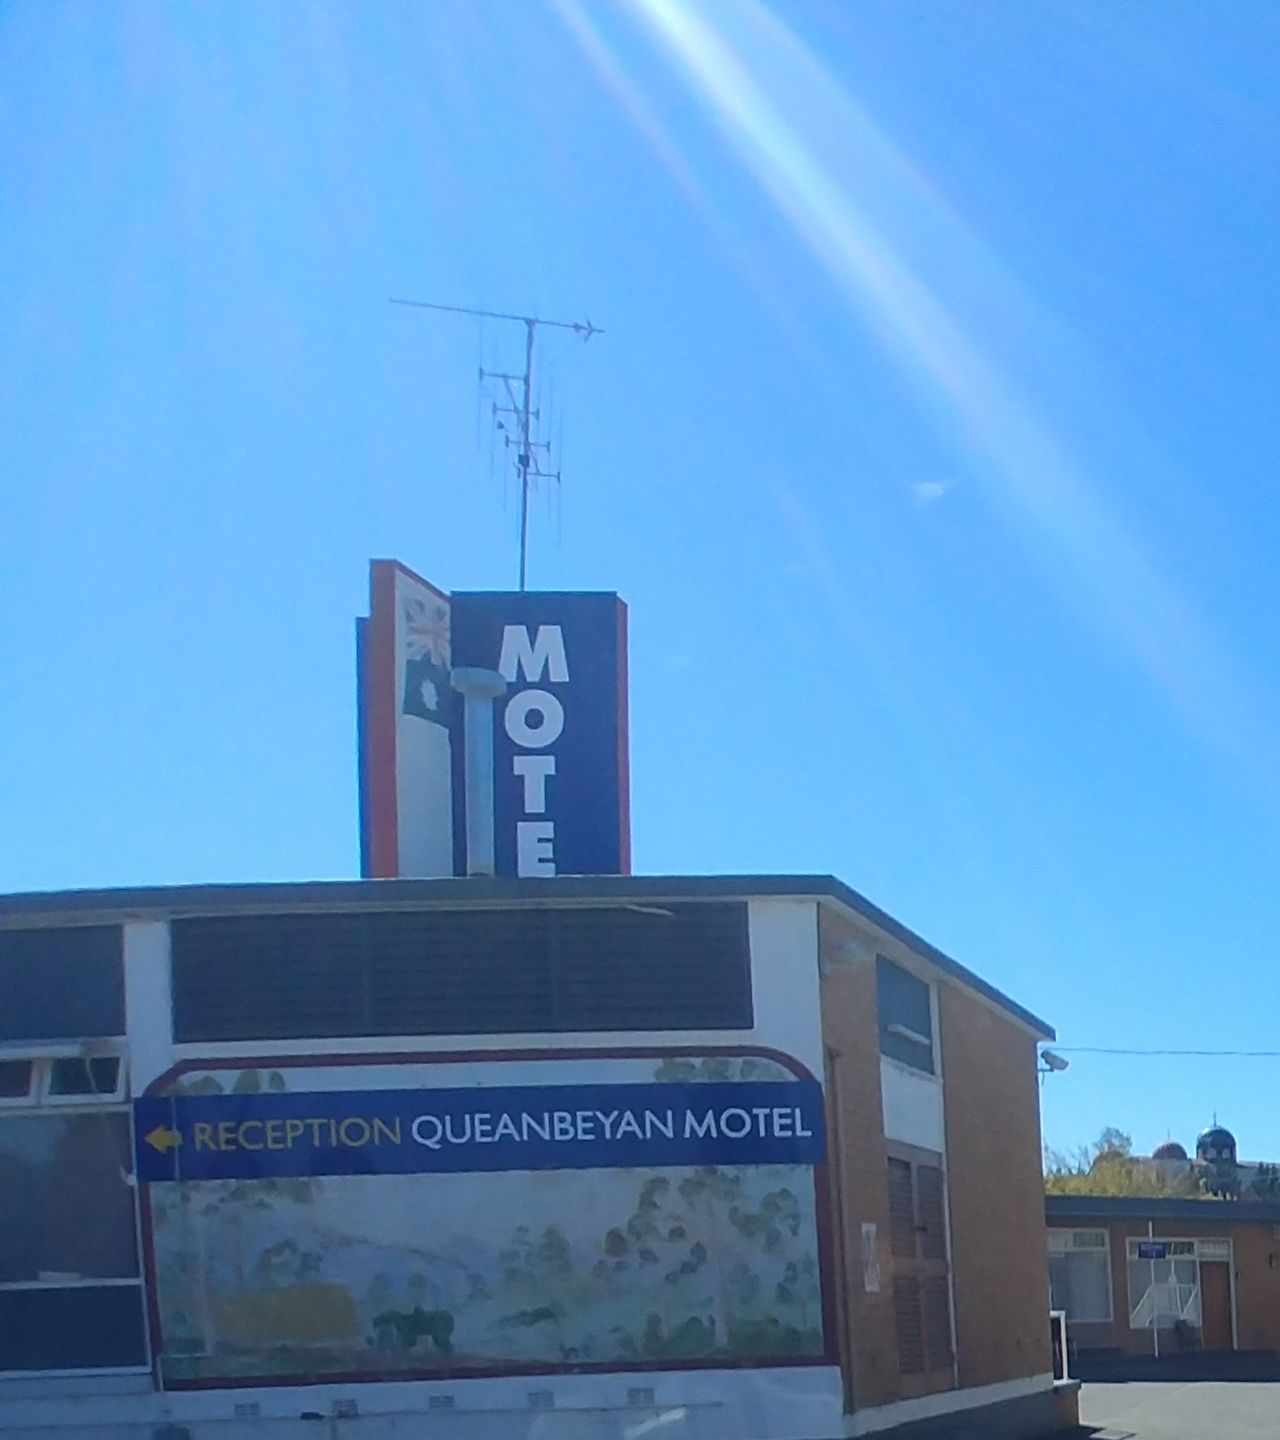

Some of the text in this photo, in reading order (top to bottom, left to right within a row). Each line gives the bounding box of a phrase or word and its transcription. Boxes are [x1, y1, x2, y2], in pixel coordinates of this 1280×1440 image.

[193, 1108, 812, 1152] RECEPTION QUEANBEYAN MOTEL
